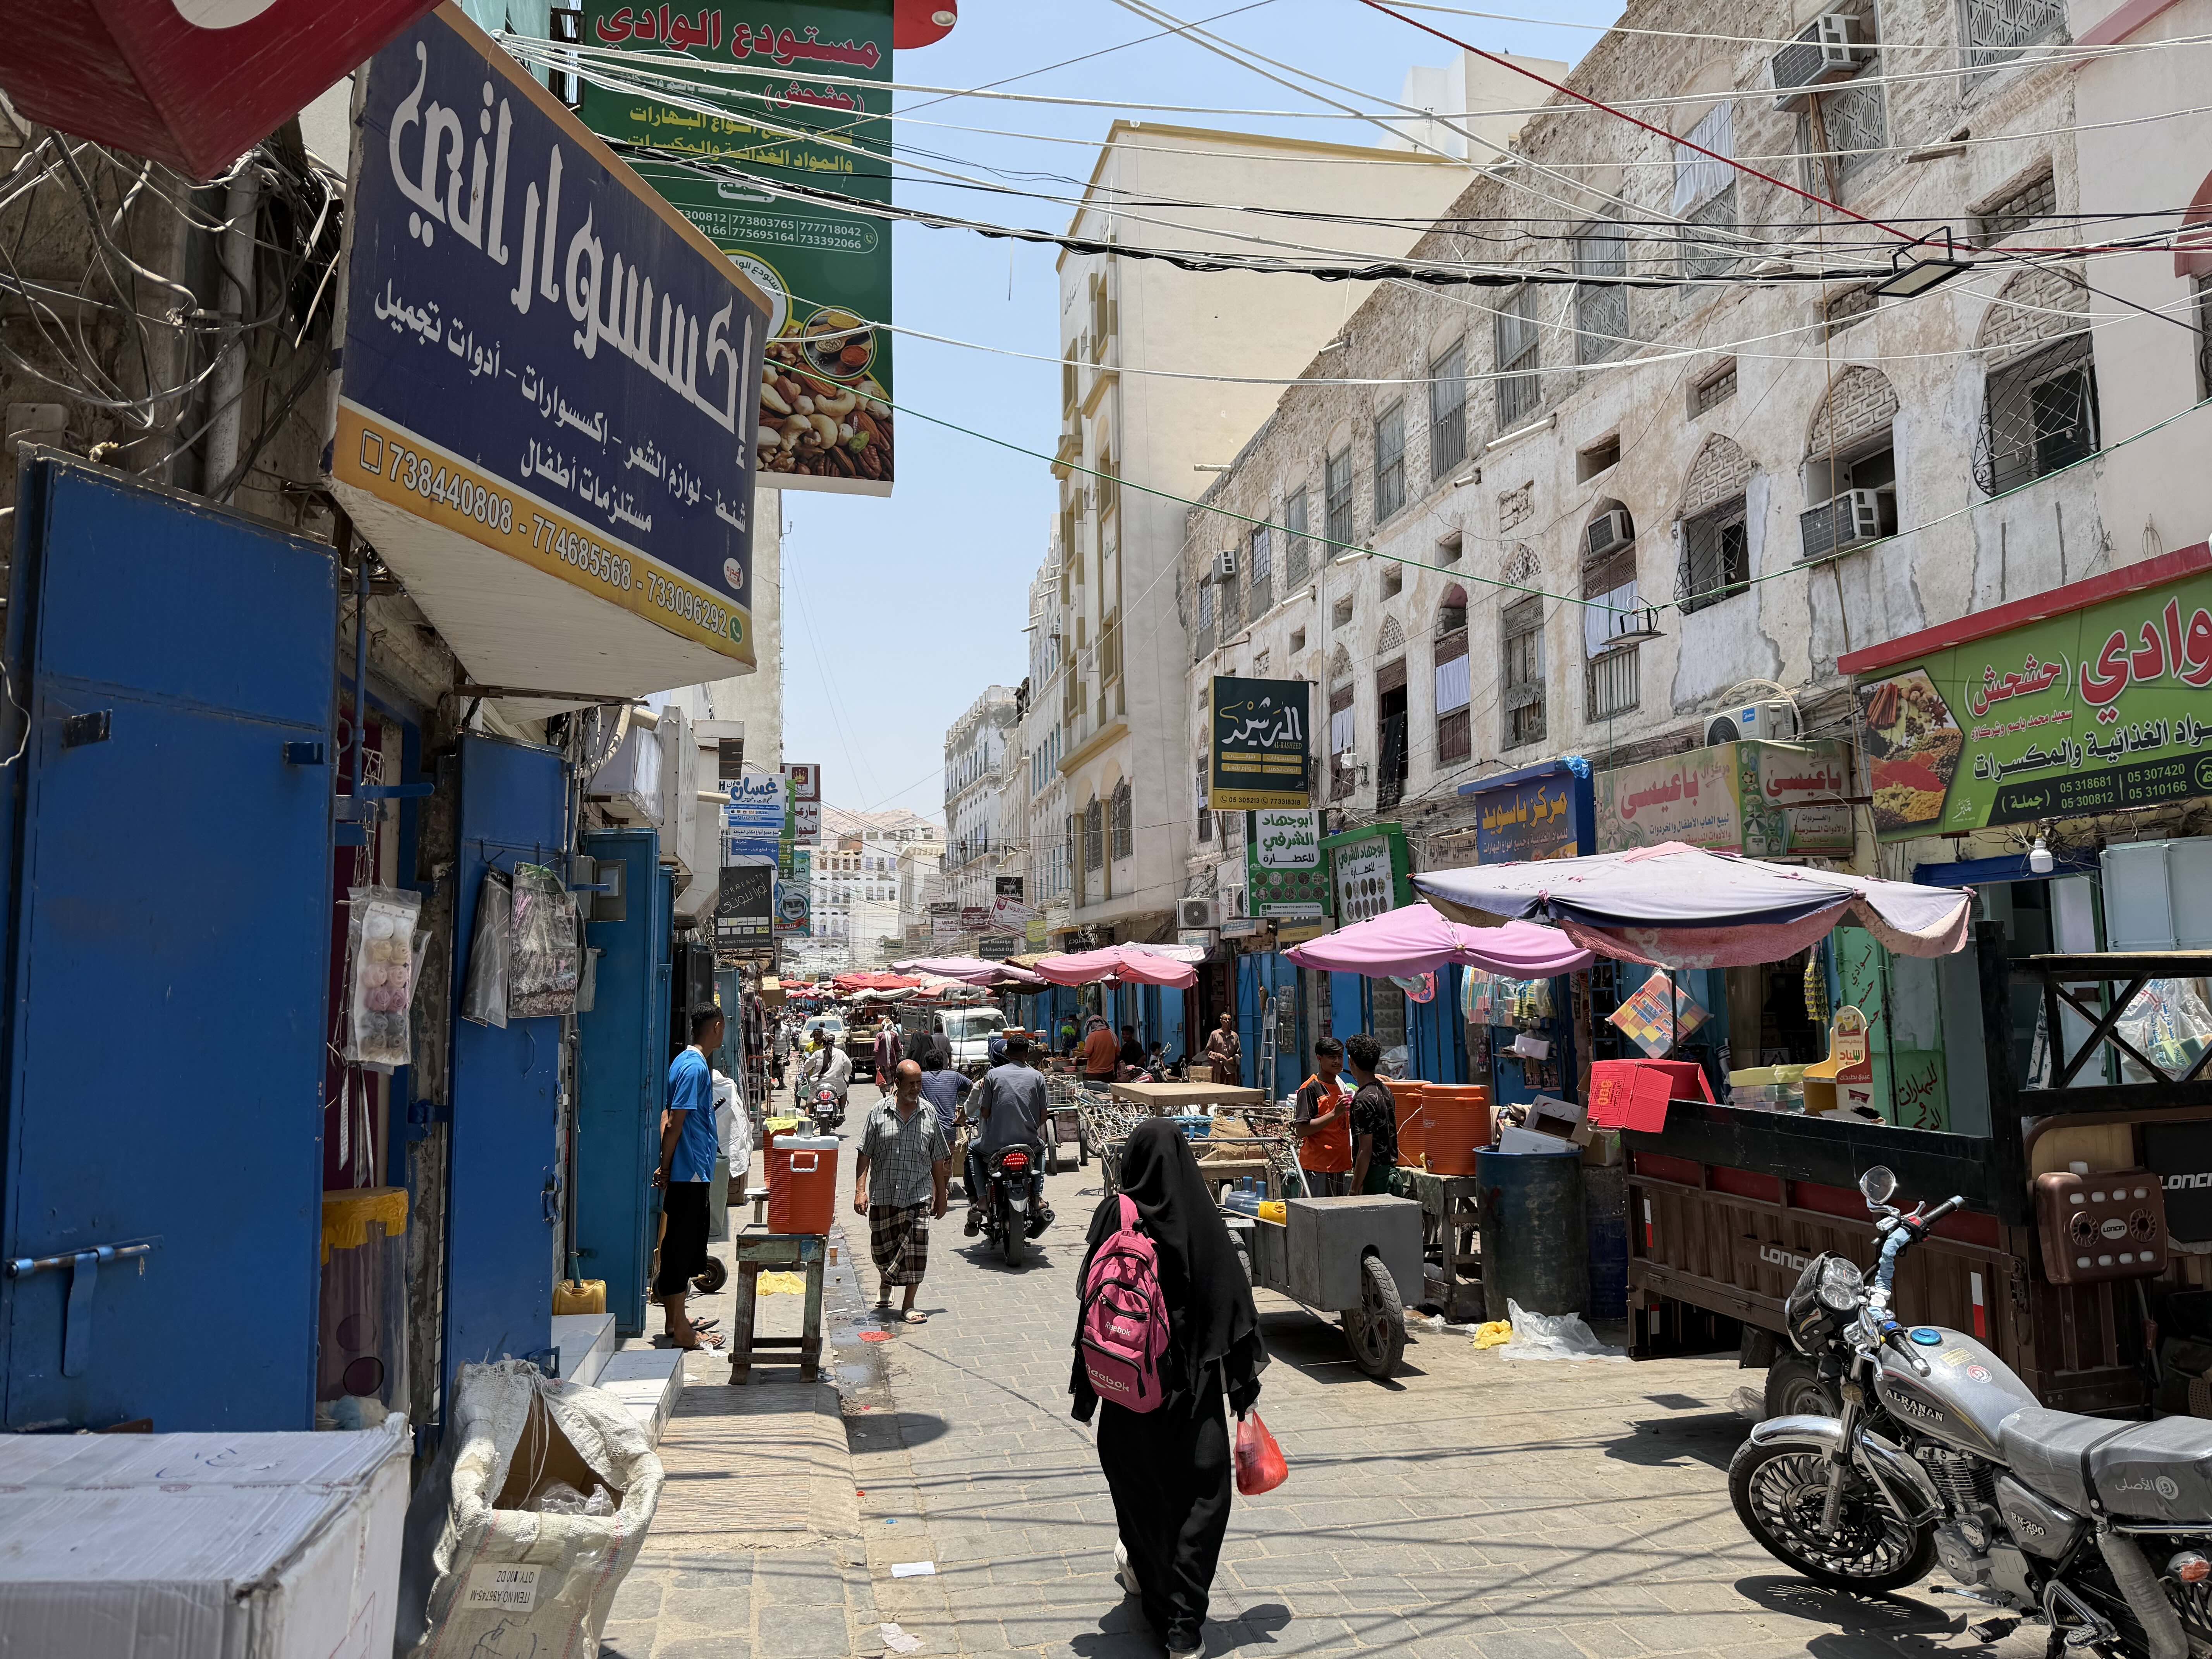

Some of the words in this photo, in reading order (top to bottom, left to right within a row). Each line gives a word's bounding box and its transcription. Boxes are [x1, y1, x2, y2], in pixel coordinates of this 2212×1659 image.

[595, 3, 722, 50] الوادي
[731, 22, 881, 69] مستودع
[630, 105, 706, 131] البهارات
[794, 151, 853, 173] والمواد
[732, 215, 795, 229] 773803765
[800, 222, 861, 237] 777718042
[732, 227, 795, 242] 775695164
[800, 234, 861, 249] 733392066
[374, 278, 442, 345] تجميل
[447, 318, 500, 379] أدوات
[521, 364, 608, 456] إكسسوارات
[520, 437, 576, 493] أطفال
[624, 440, 666, 481] الشعر
[580, 471, 652, 533] مستلزمات
[669, 471, 702, 506] لوازم
[714, 488, 746, 533] شنط
[388, 442, 512, 534] 738440808
[532, 514, 632, 591] 774685568
[646, 571, 727, 638] 733096292
[1964, 651, 2072, 720] (حشحش)
[2007, 717, 2027, 732] باصم
[2027, 713, 2050, 728] محمد
[2051, 709, 2073, 725] سعيد
[1273, 741, 1302, 749] AL-RASHEED
[2086, 717, 2169, 763] الغذائية
[1973, 737, 2083, 783] والمكسرات
[730, 777, 778, 800] غسان
[2060, 781, 2073, 794] 05
[2075, 775, 2112, 792] 318681
[2128, 771, 2141, 783] 05
[2144, 763, 2185, 781] 307420
[1530, 785, 1568, 828] مركز
[2061, 797, 2074, 809] 05
[2076, 792, 2114, 807] 300812
[2129, 788, 2142, 800] 05
[2145, 780, 2188, 799] 310166
[1262, 831, 1314, 852] الشرفي
[1338, 845, 1360, 870] الشرفي
[2102, 1223, 2126, 1233] LONCIN
[1760, 1245, 1814, 1272] LONCI
[1104, 1321, 1132, 1336] Reebok
[1085, 1363, 1130, 1392] Reebok
[1885, 1388, 1945, 1422] ALRANAN
[1903, 1404, 1926, 1419] VIP
[2115, 1477, 2155, 1493] الأصلي
[2010, 1511, 2045, 1536] RN-200
[2020, 1524, 2037, 1536] VIP
[496, 1571, 507, 1583] DZ
